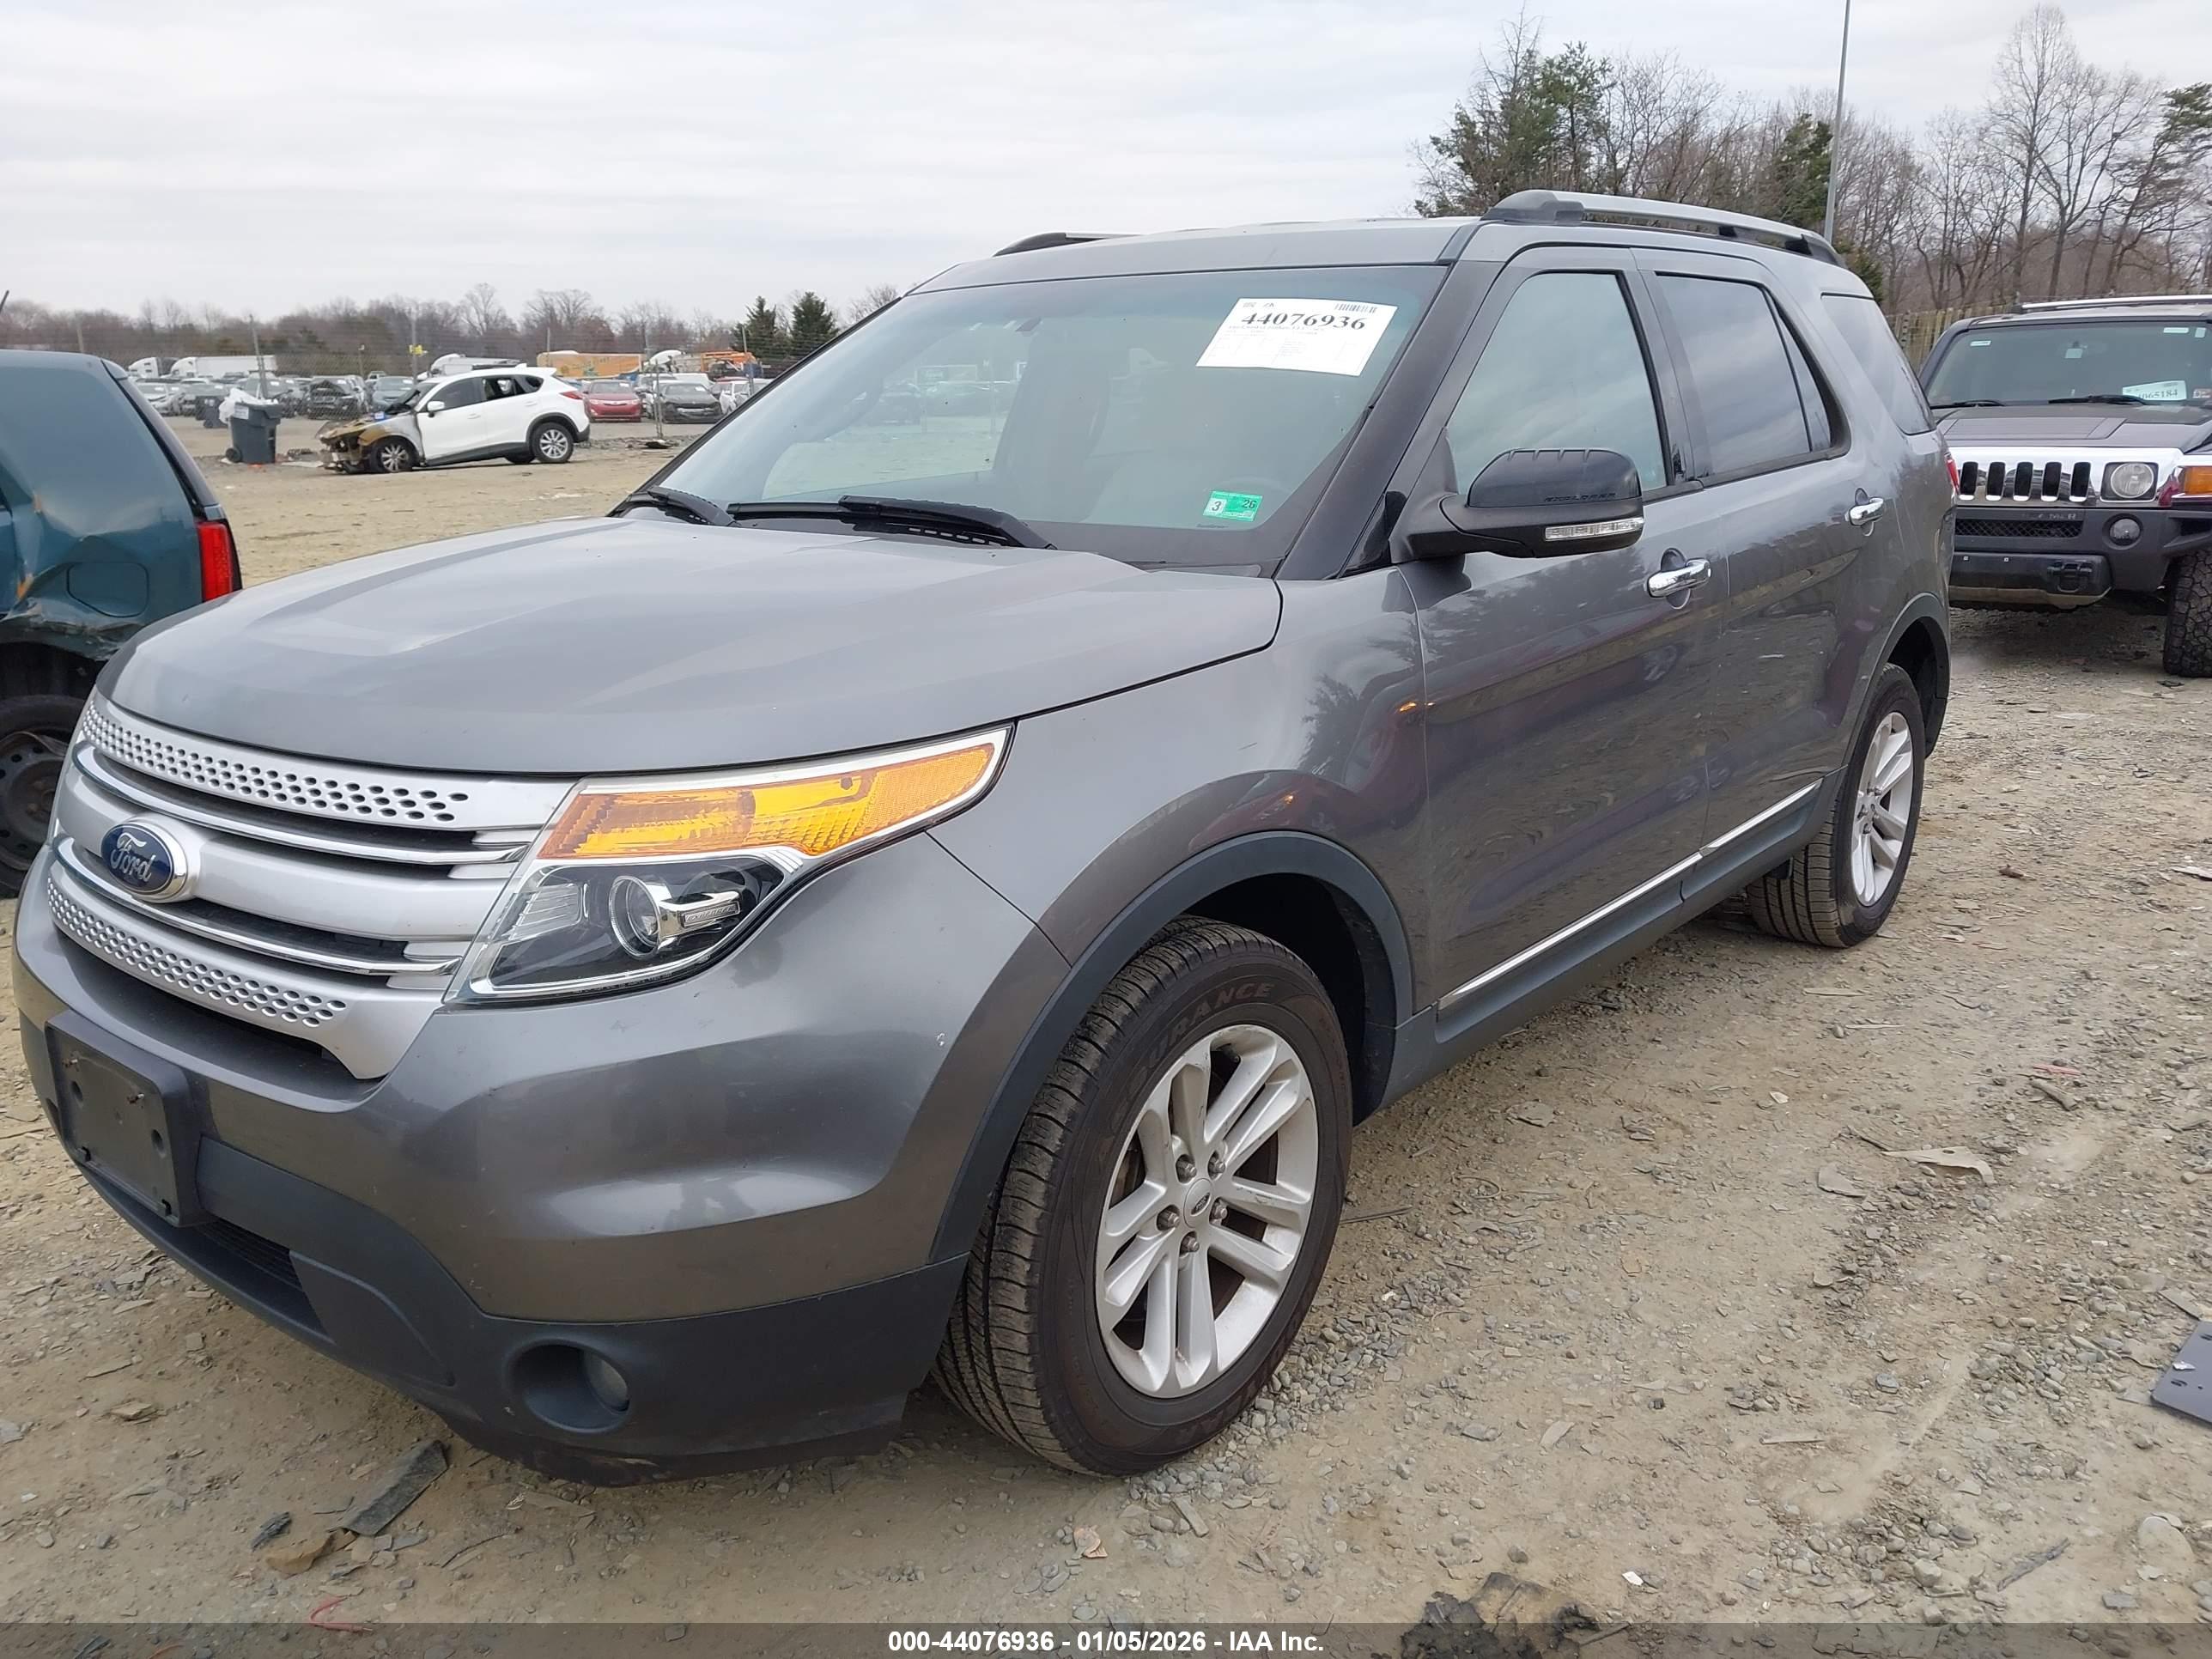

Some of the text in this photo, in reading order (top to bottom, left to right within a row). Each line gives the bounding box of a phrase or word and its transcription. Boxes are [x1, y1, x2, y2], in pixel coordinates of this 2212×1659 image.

[1241, 313, 1367, 330] 44076936
[1212, 499, 1257, 511] 3 26
[109, 832, 156, 883] Ford
